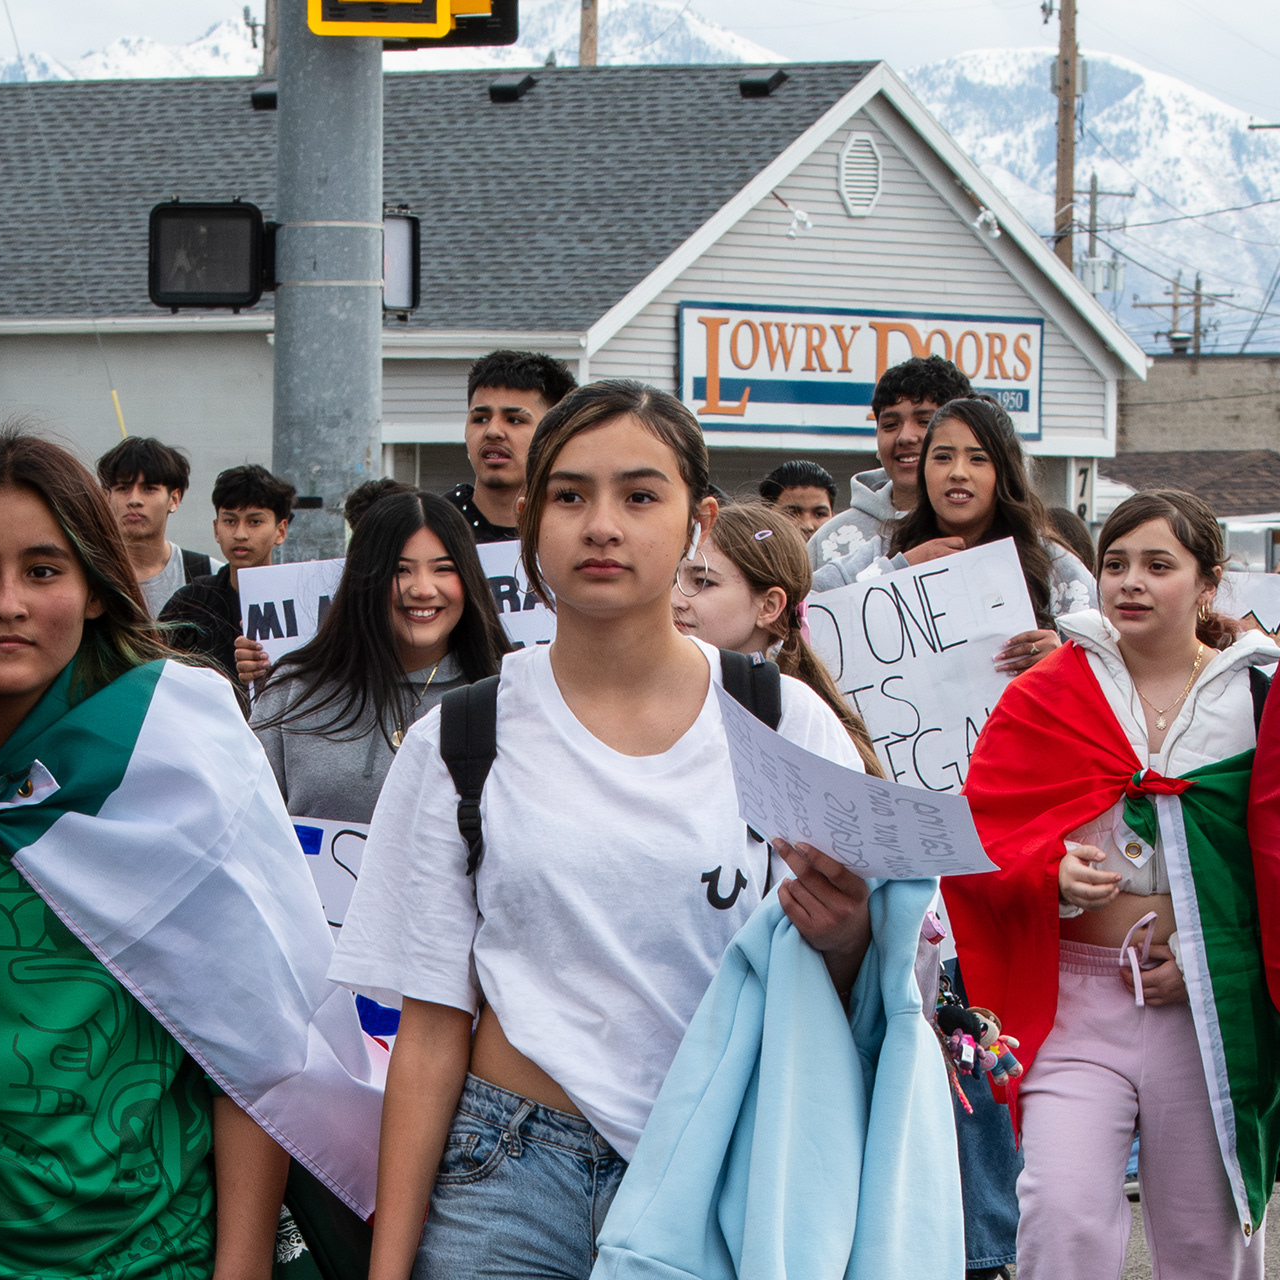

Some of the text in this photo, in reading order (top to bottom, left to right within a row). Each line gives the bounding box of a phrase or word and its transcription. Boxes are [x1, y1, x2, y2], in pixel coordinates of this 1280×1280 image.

[697, 316, 861, 416] LOWRY
[246, 598, 299, 642] MI
[862, 567, 968, 665] ONE
